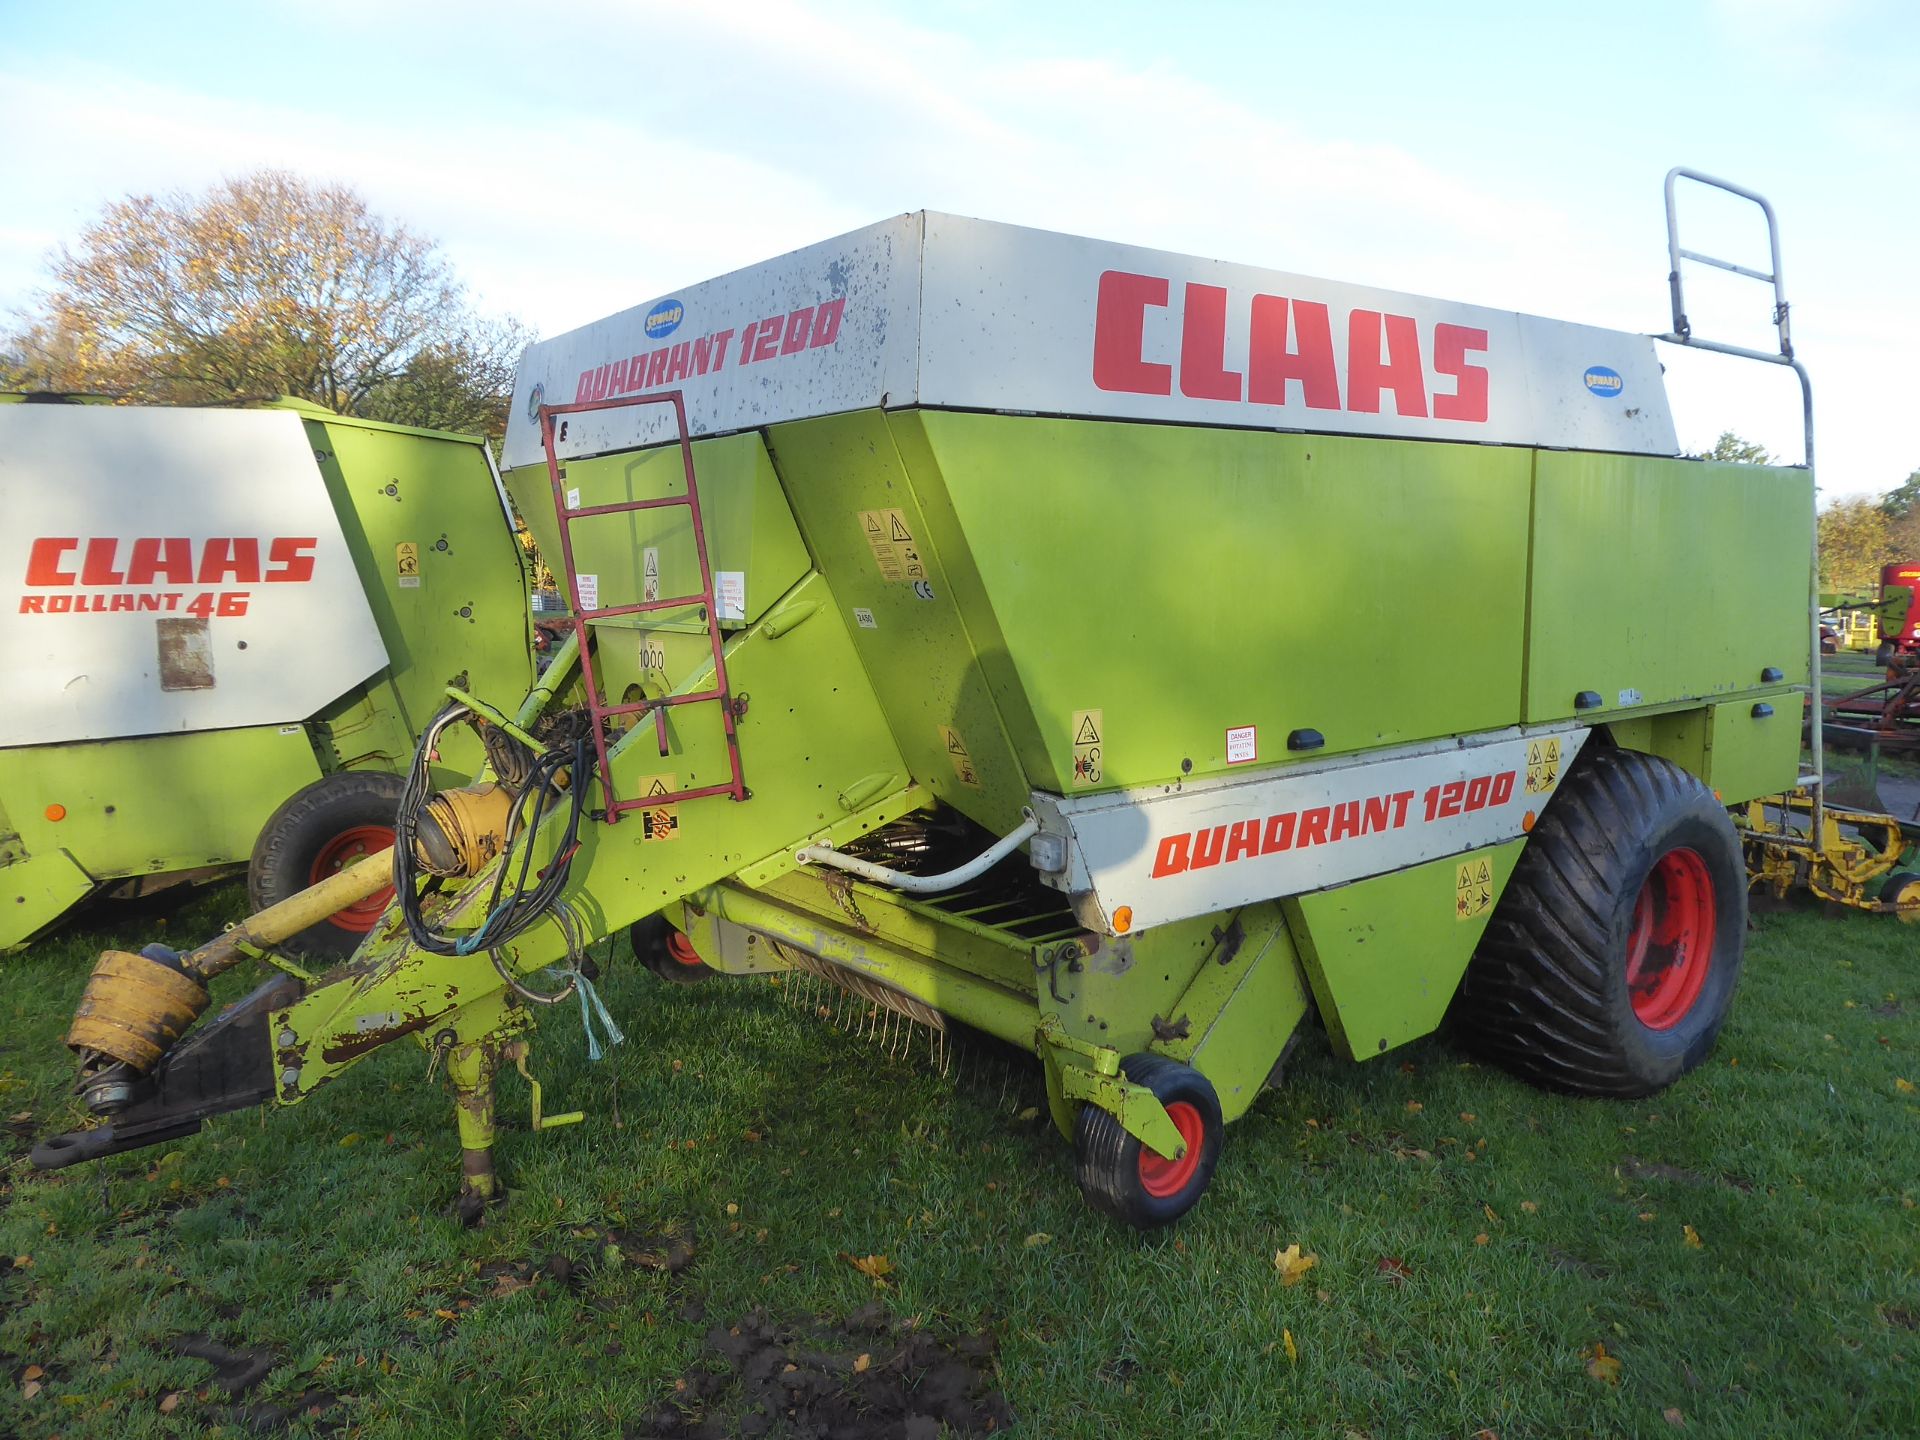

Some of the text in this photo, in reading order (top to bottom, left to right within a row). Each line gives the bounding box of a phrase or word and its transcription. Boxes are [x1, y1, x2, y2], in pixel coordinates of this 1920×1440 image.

[576, 297, 846, 402] QUADRANT 1200
[1092, 269, 1489, 423] CLAAS
[25, 537, 318, 587] CLAAS
[19, 591, 251, 619] ROLLANT 46
[640, 649, 664, 670] 1000
[1229, 741, 1252, 750] ROTATING
[1230, 731, 1252, 740] DANGER
[1151, 770, 1516, 879] QUADRANT 1200
